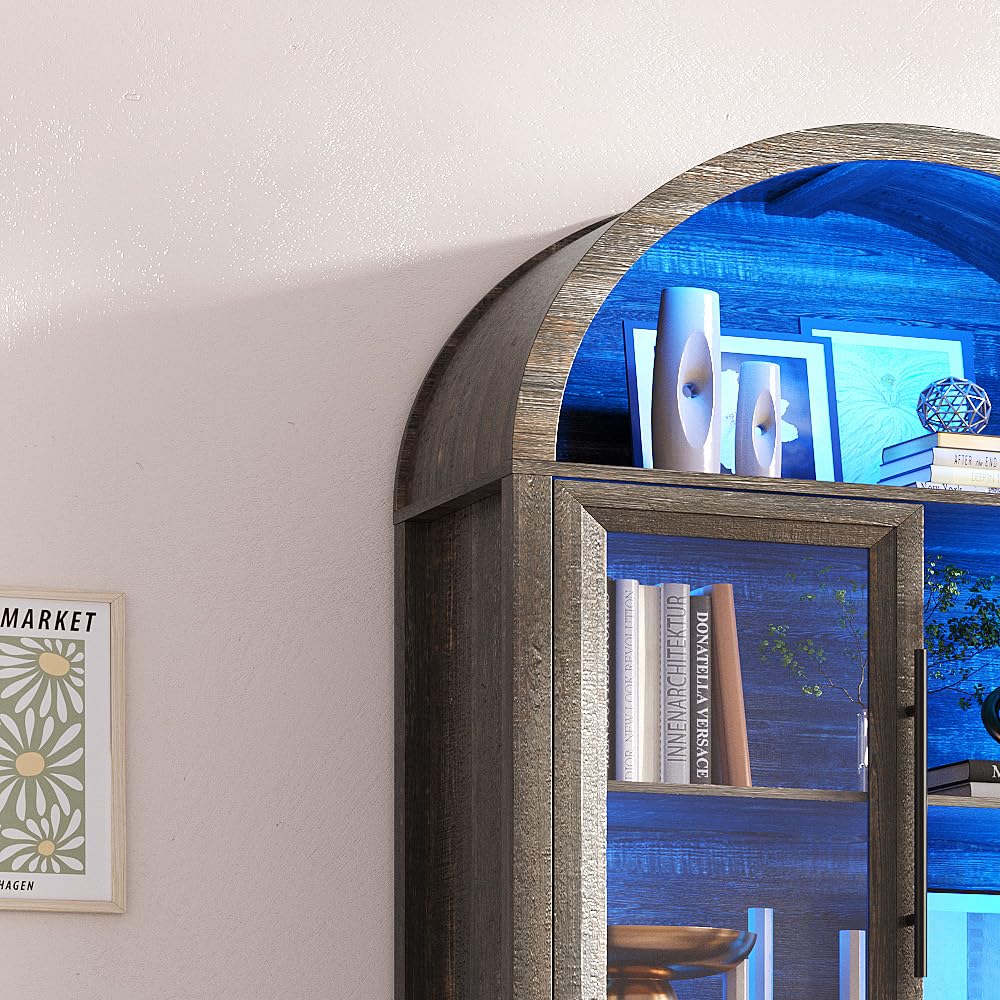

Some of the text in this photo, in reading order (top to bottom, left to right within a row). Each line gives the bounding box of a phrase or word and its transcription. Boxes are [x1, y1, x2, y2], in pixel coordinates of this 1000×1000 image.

[954, 454, 972, 466] AFTER
[985, 456, 998, 468] END
[0, 607, 97, 632] MARKET
[666, 595, 687, 762] INNENARCHITEKTUR
[696, 611, 709, 778] DONATELLA VERSACE
